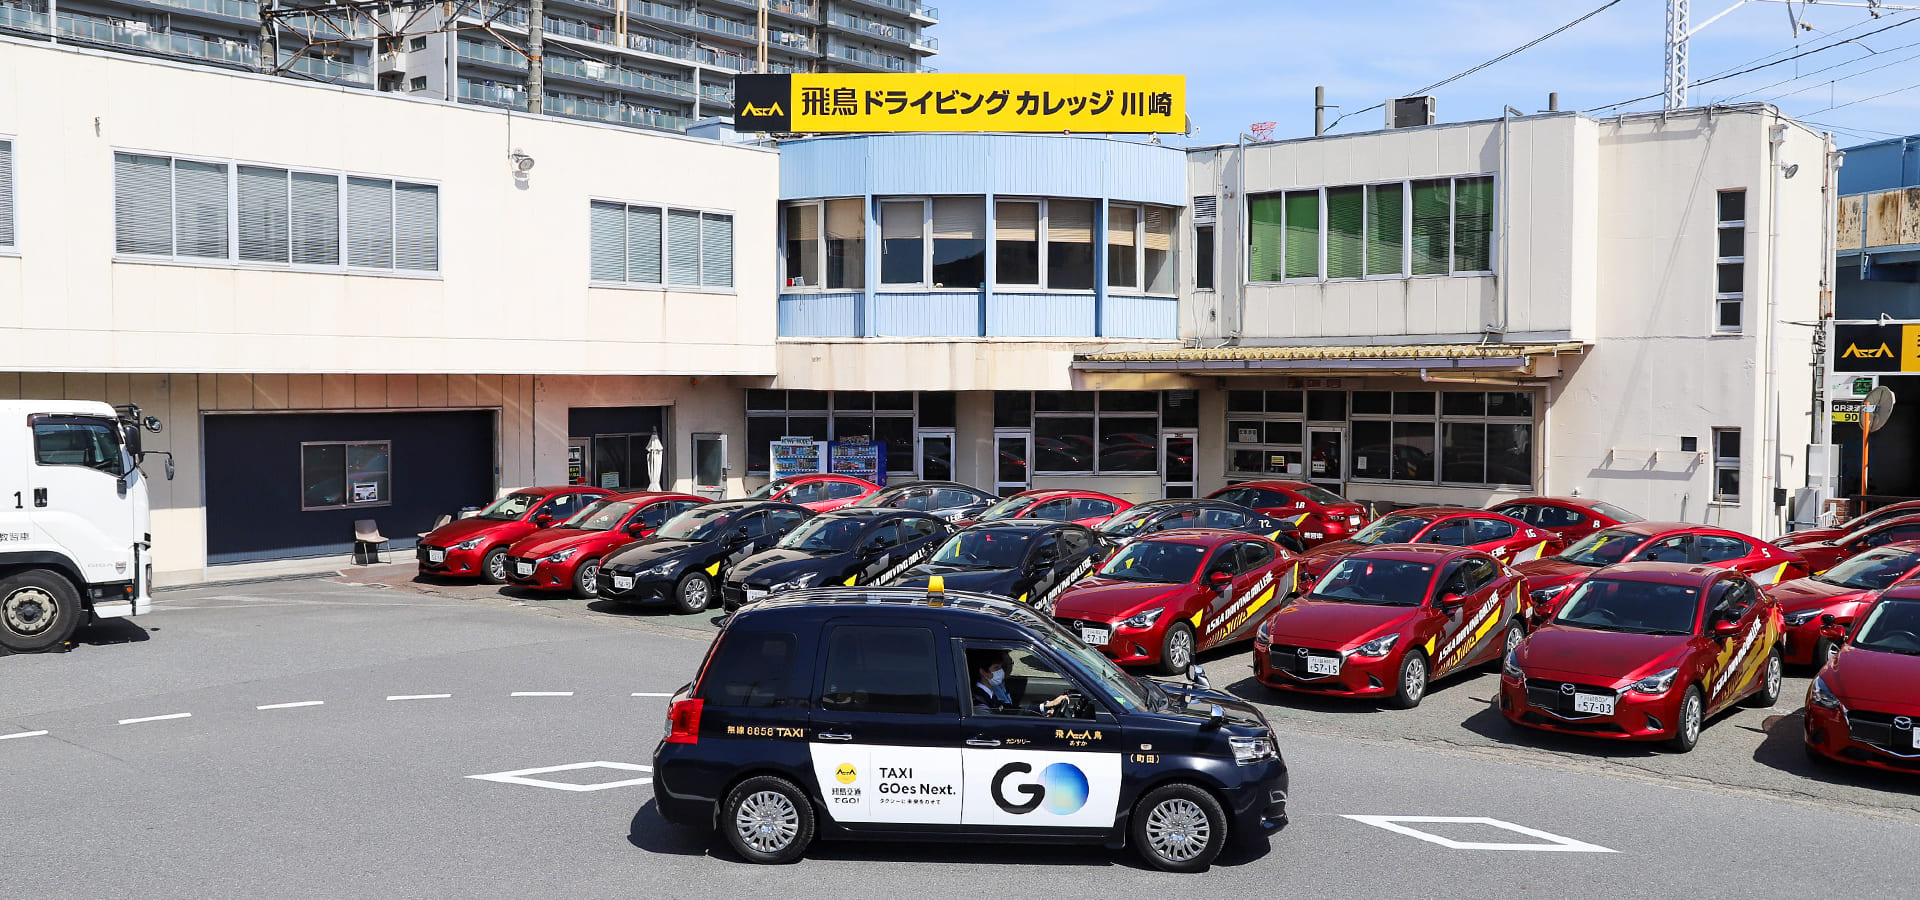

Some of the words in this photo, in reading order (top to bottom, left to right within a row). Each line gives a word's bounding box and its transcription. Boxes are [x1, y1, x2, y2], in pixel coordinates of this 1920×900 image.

[801, 87, 858, 116] 飛鳥
[865, 89, 1010, 116] ドライビング
[1015, 90, 1115, 116] カレッジ
[1120, 91, 1173, 117] 川崎
[14, 491, 23, 509] 1
[1258, 519, 1272, 529] 72
[1593, 520, 1600, 528] 8
[1525, 528, 1537, 538] 16
[1761, 547, 1771, 558] 5
[1206, 613, 1225, 636] ASKA
[1583, 701, 1612, 714] 57-03
[776, 727, 804, 738] TAXI
[879, 767, 913, 779] TAXI
[878, 782, 917, 794] GOes
[919, 783, 956, 795] Next.
